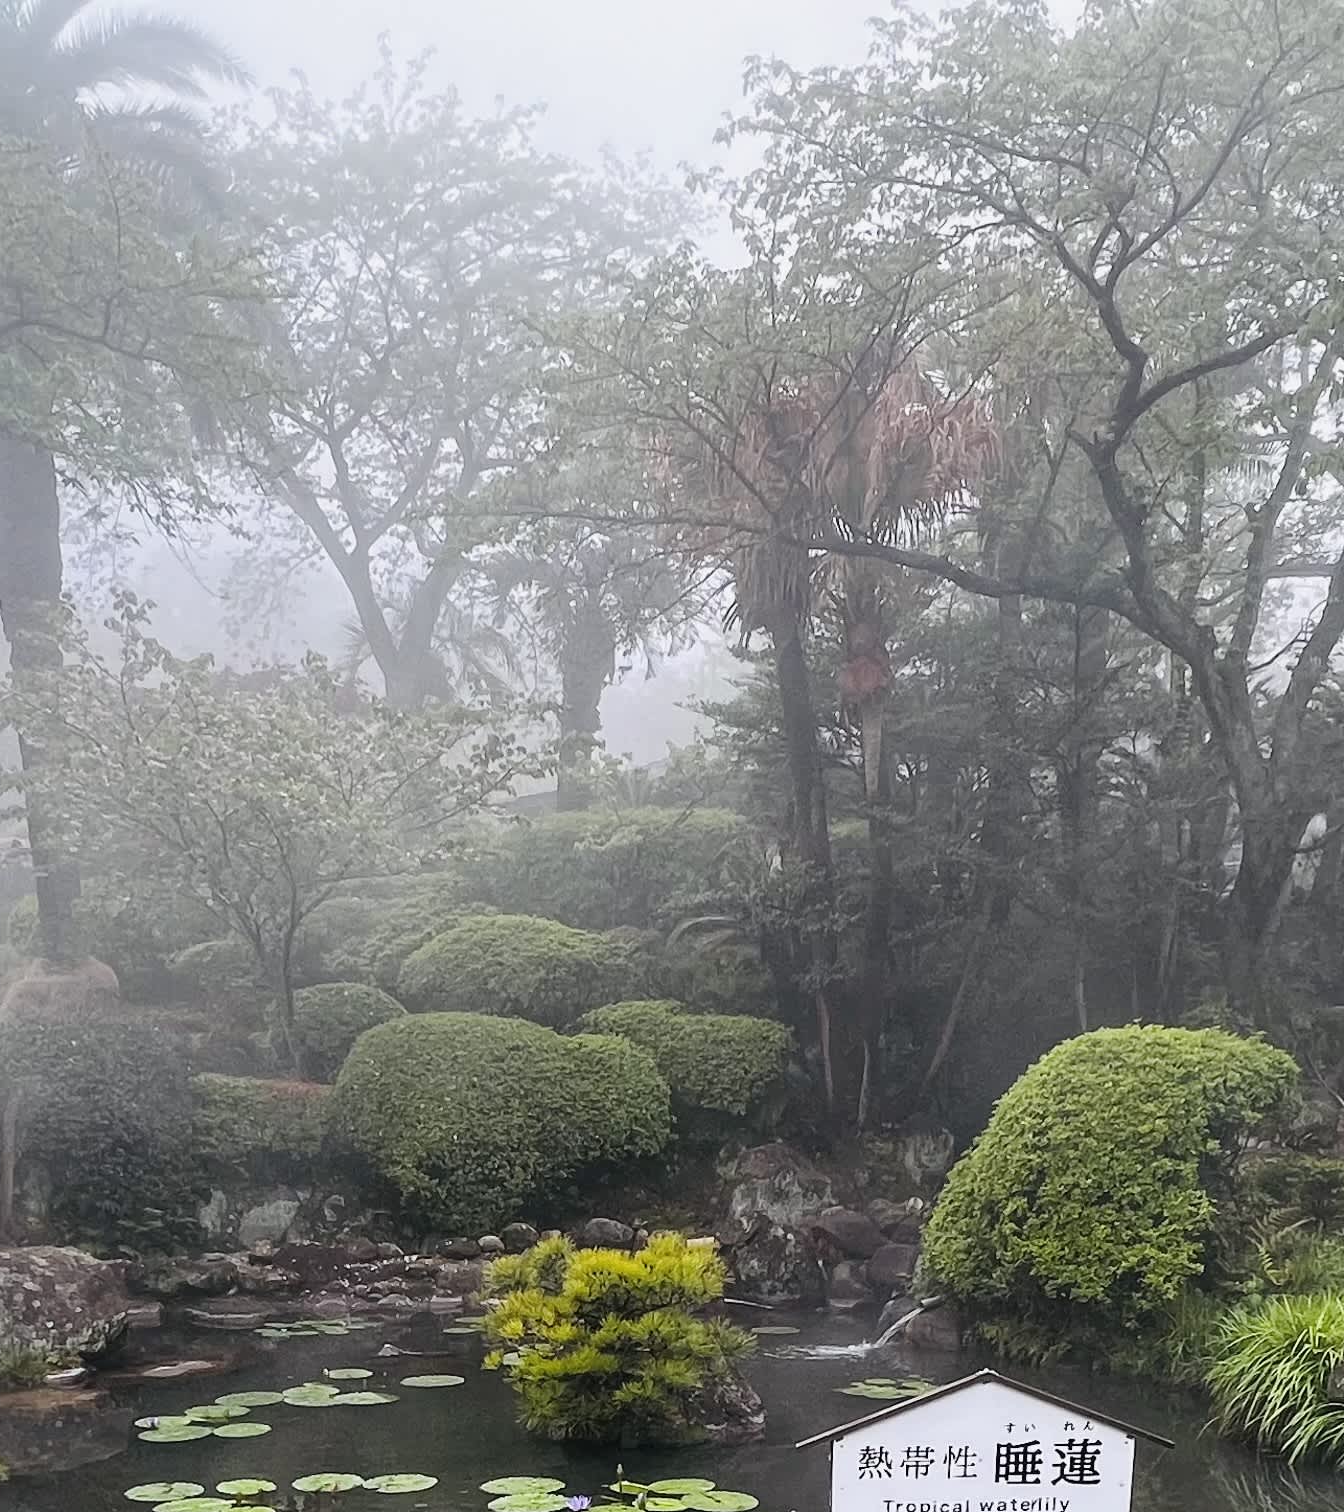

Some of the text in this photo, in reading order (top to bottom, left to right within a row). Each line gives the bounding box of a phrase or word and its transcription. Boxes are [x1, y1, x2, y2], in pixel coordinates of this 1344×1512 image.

[1004, 1420, 1094, 1433] すい れん
[994, 1438, 1103, 1486] 睡蓮
